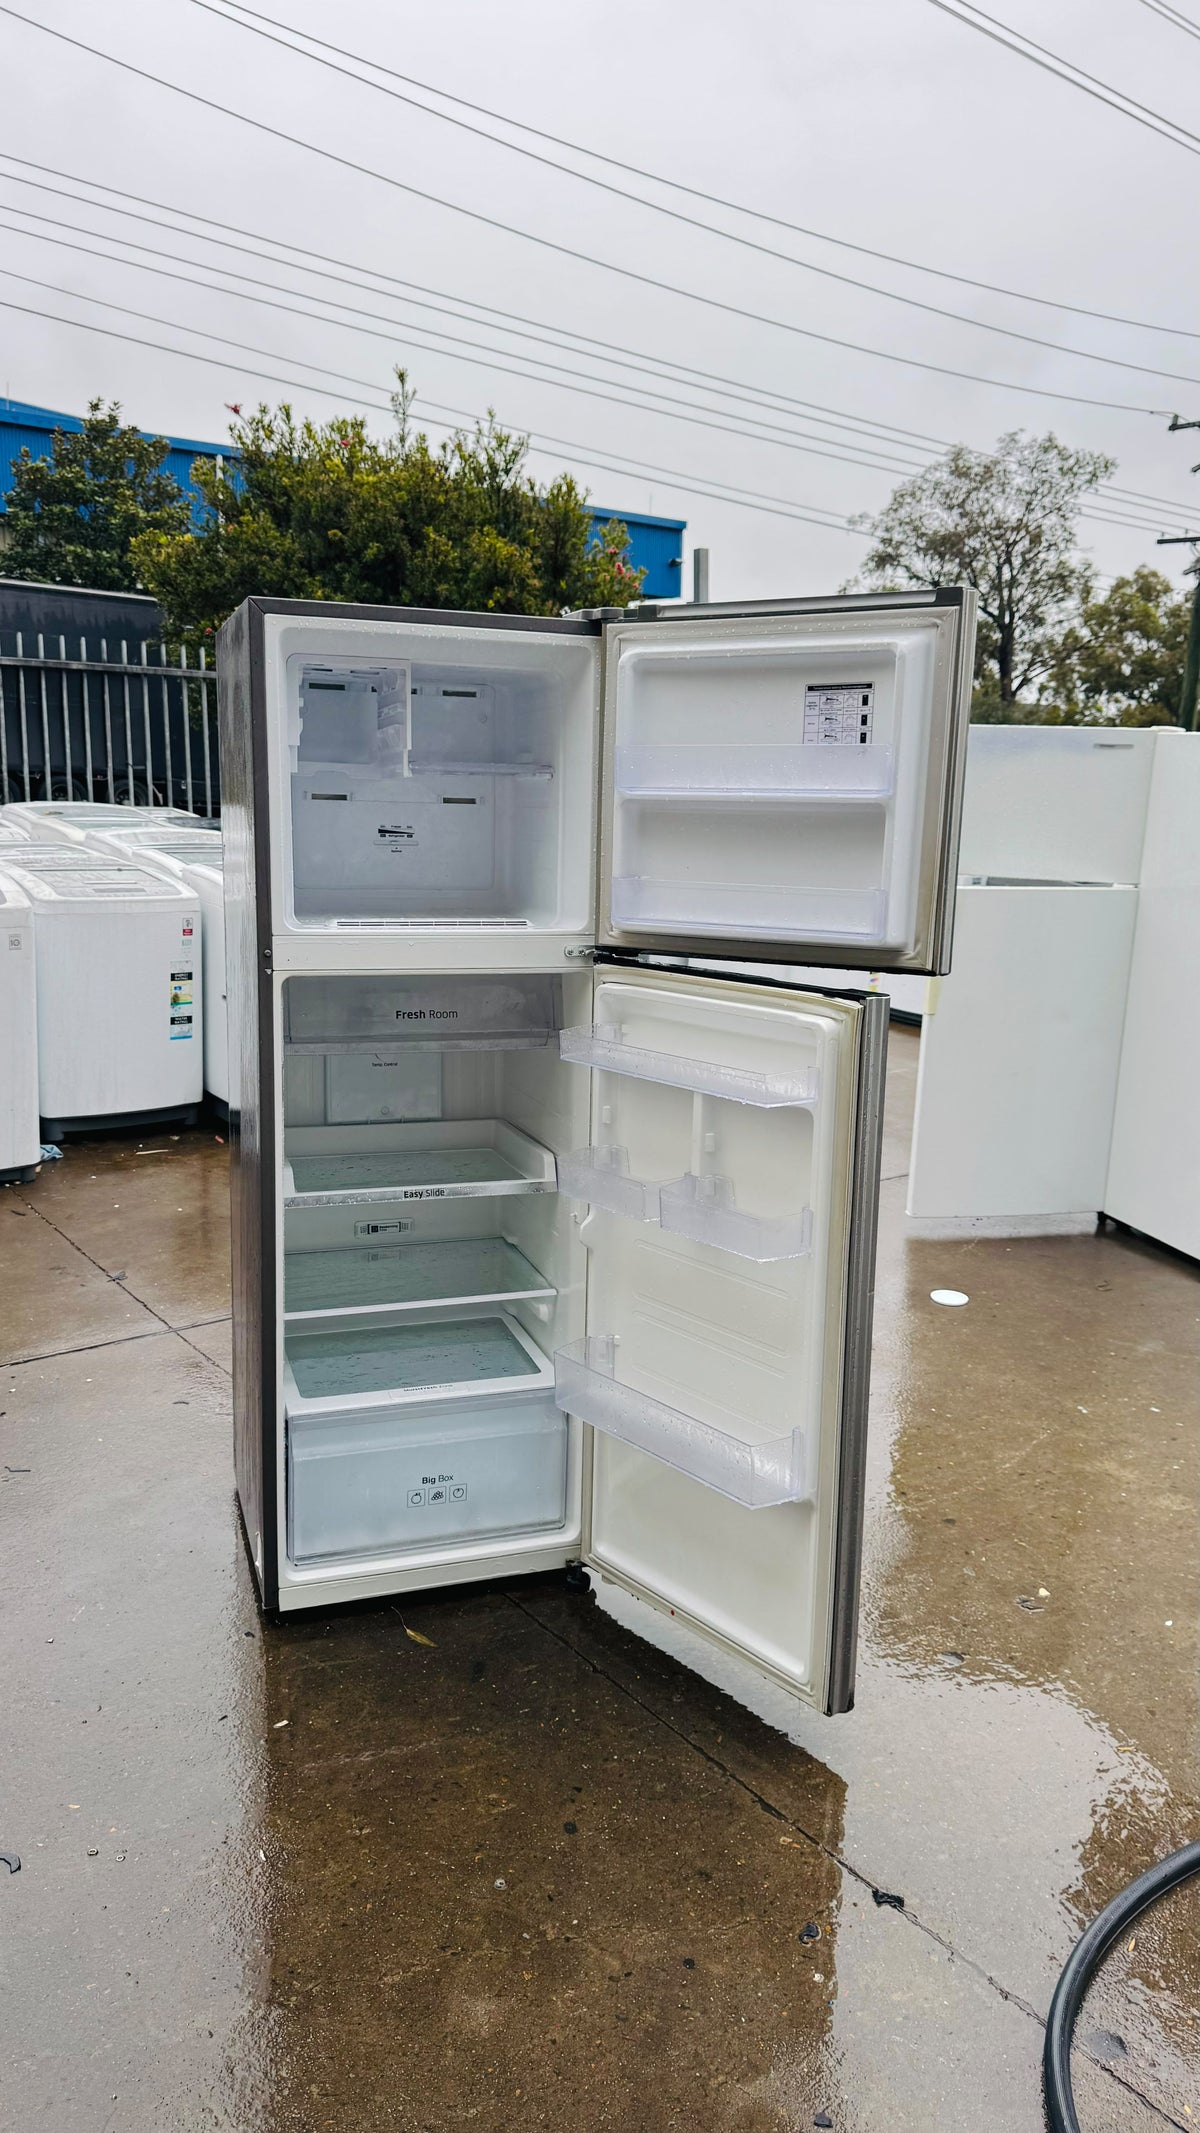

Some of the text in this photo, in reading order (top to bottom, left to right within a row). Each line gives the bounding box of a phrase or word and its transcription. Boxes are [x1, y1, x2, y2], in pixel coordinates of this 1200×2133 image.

[395, 1009, 458, 1019] Fresh Room
[403, 1187, 445, 1199] Easy Slide
[422, 1474, 454, 1485] Big Box
